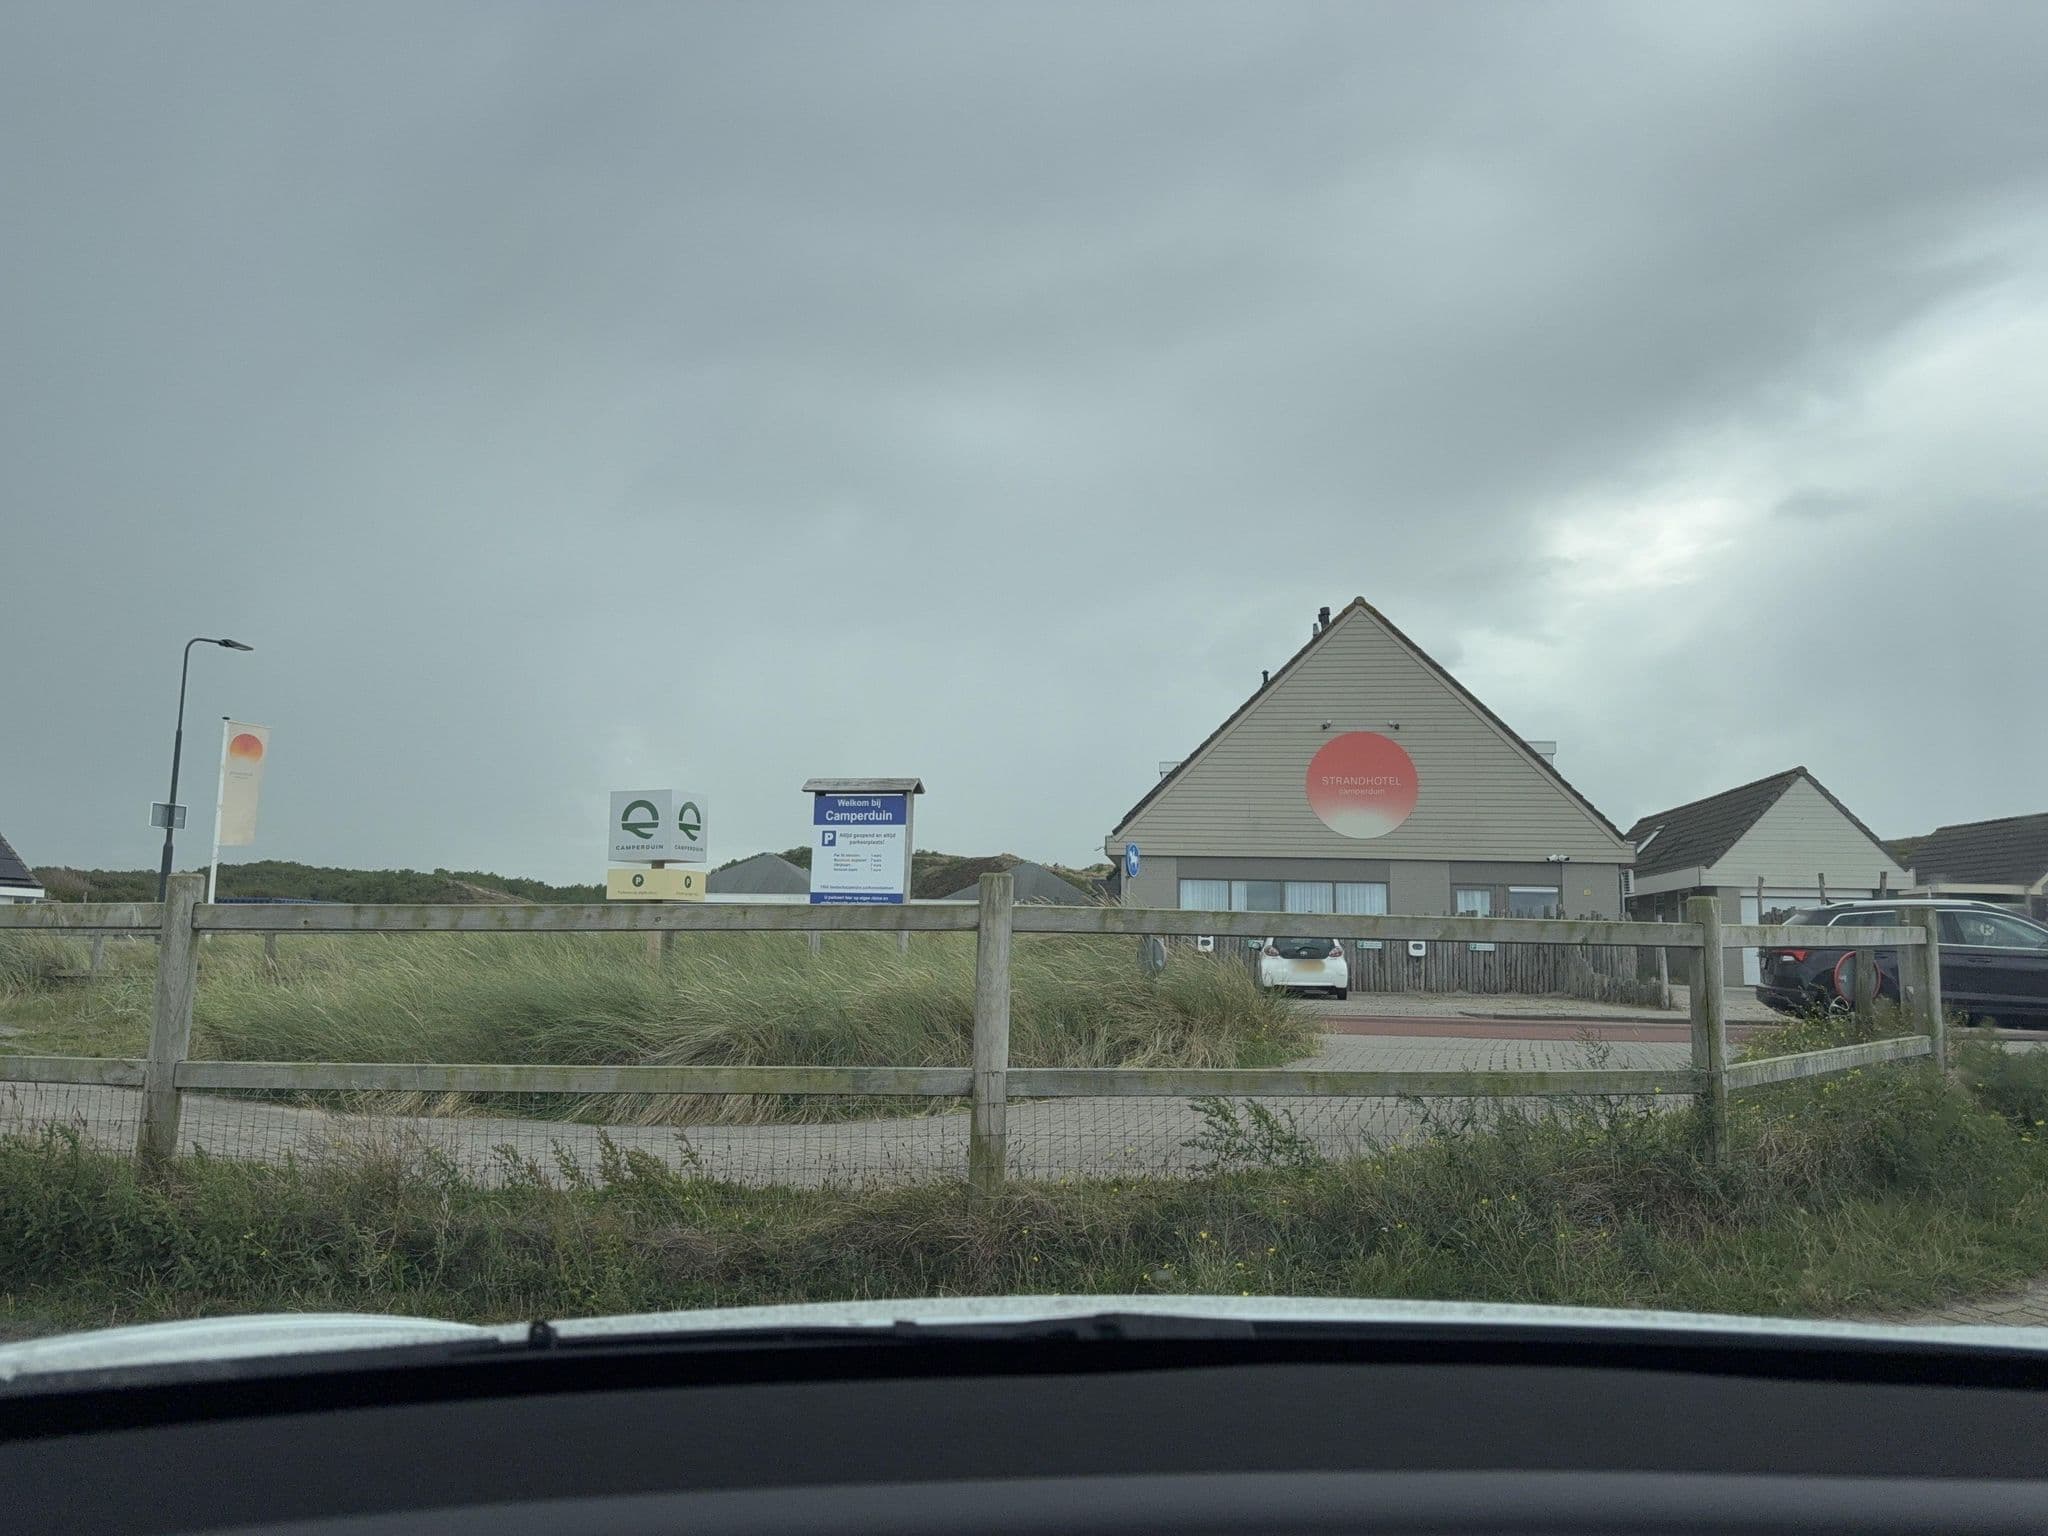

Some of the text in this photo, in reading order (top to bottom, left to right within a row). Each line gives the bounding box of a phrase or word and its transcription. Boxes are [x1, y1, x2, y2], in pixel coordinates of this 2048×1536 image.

[1321, 776, 1401, 785] STRANDHOTEL
[838, 799, 881, 809] Welkom bij
[825, 810, 893, 823] Camperduin
[824, 832, 834, 845] P
